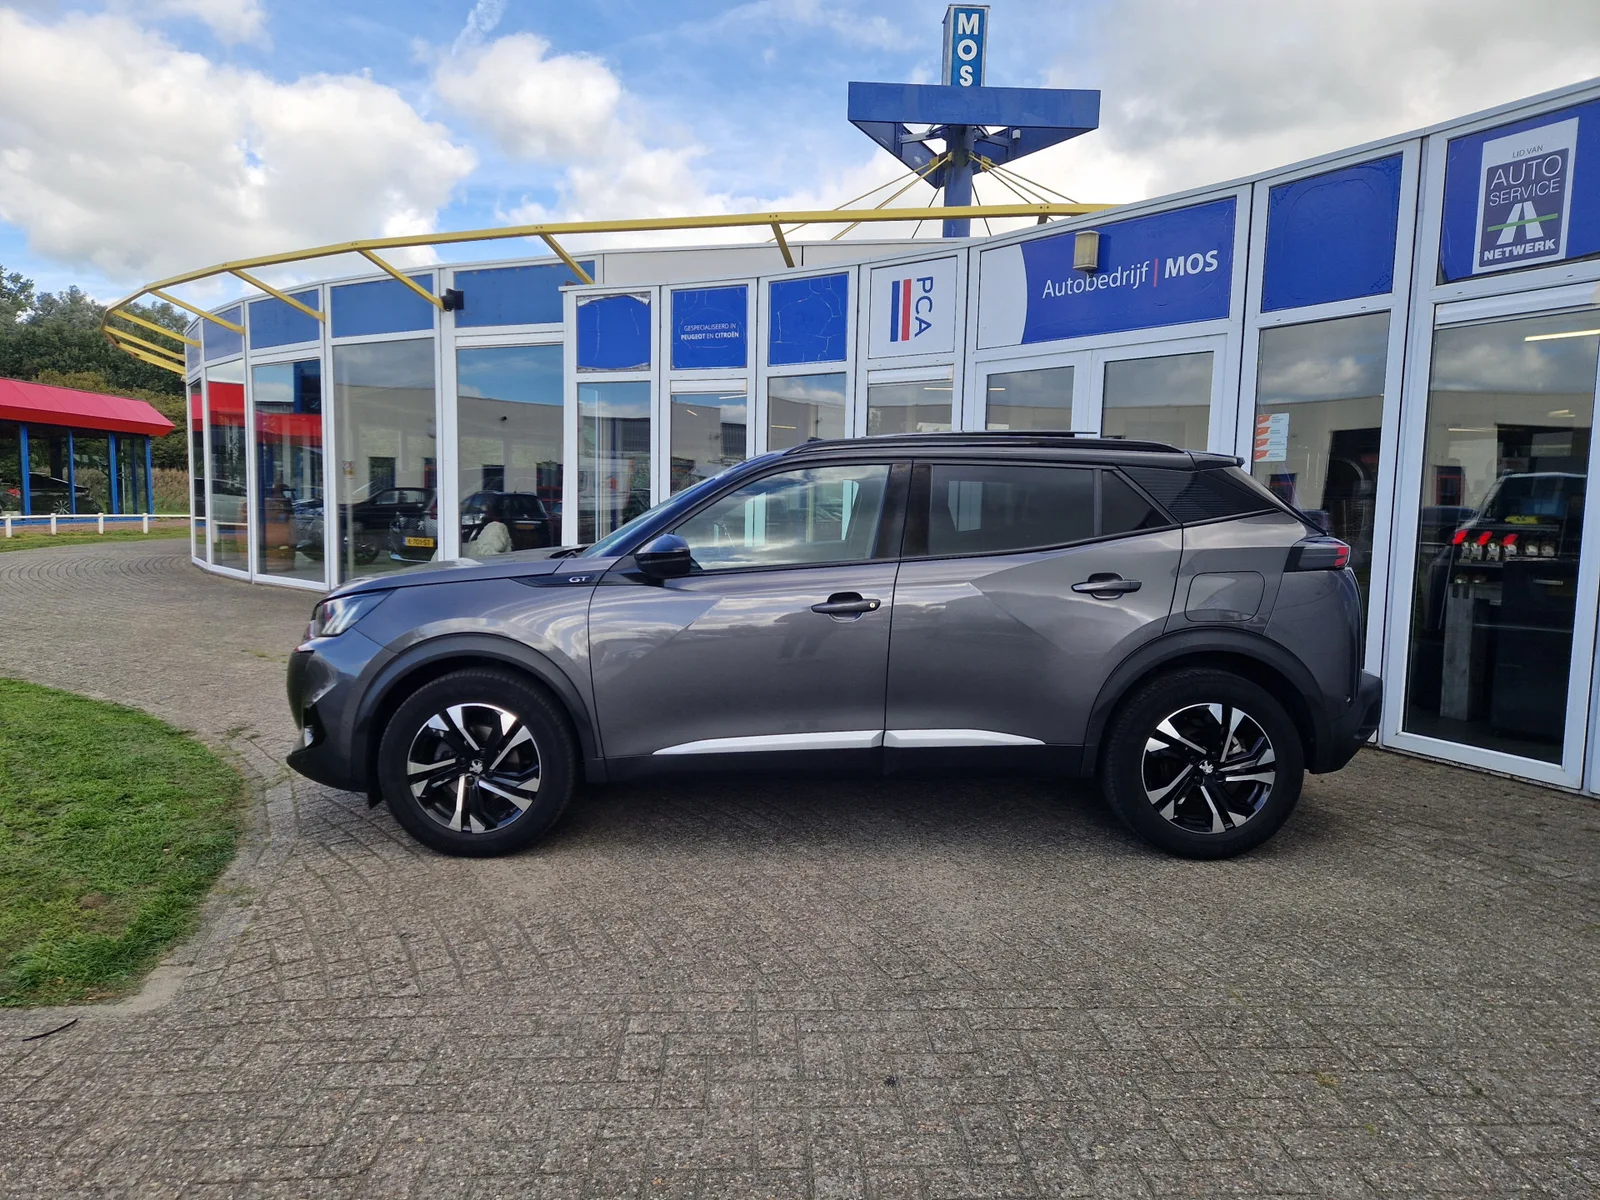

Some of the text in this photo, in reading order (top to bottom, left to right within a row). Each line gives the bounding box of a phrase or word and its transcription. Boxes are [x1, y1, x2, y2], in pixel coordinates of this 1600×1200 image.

[957, 12, 979, 87] MOS
[1512, 145, 1544, 159] LID VAN
[1490, 154, 1562, 190] AUTO
[1489, 177, 1561, 206] SERVICE
[1484, 239, 1556, 261] NETWERK
[1042, 250, 1218, 299] Autobedrijf MOS
[914, 276, 934, 338] PCA
[684, 323, 729, 331] GESPECIALISEERD
[568, 575, 590, 583] GT
